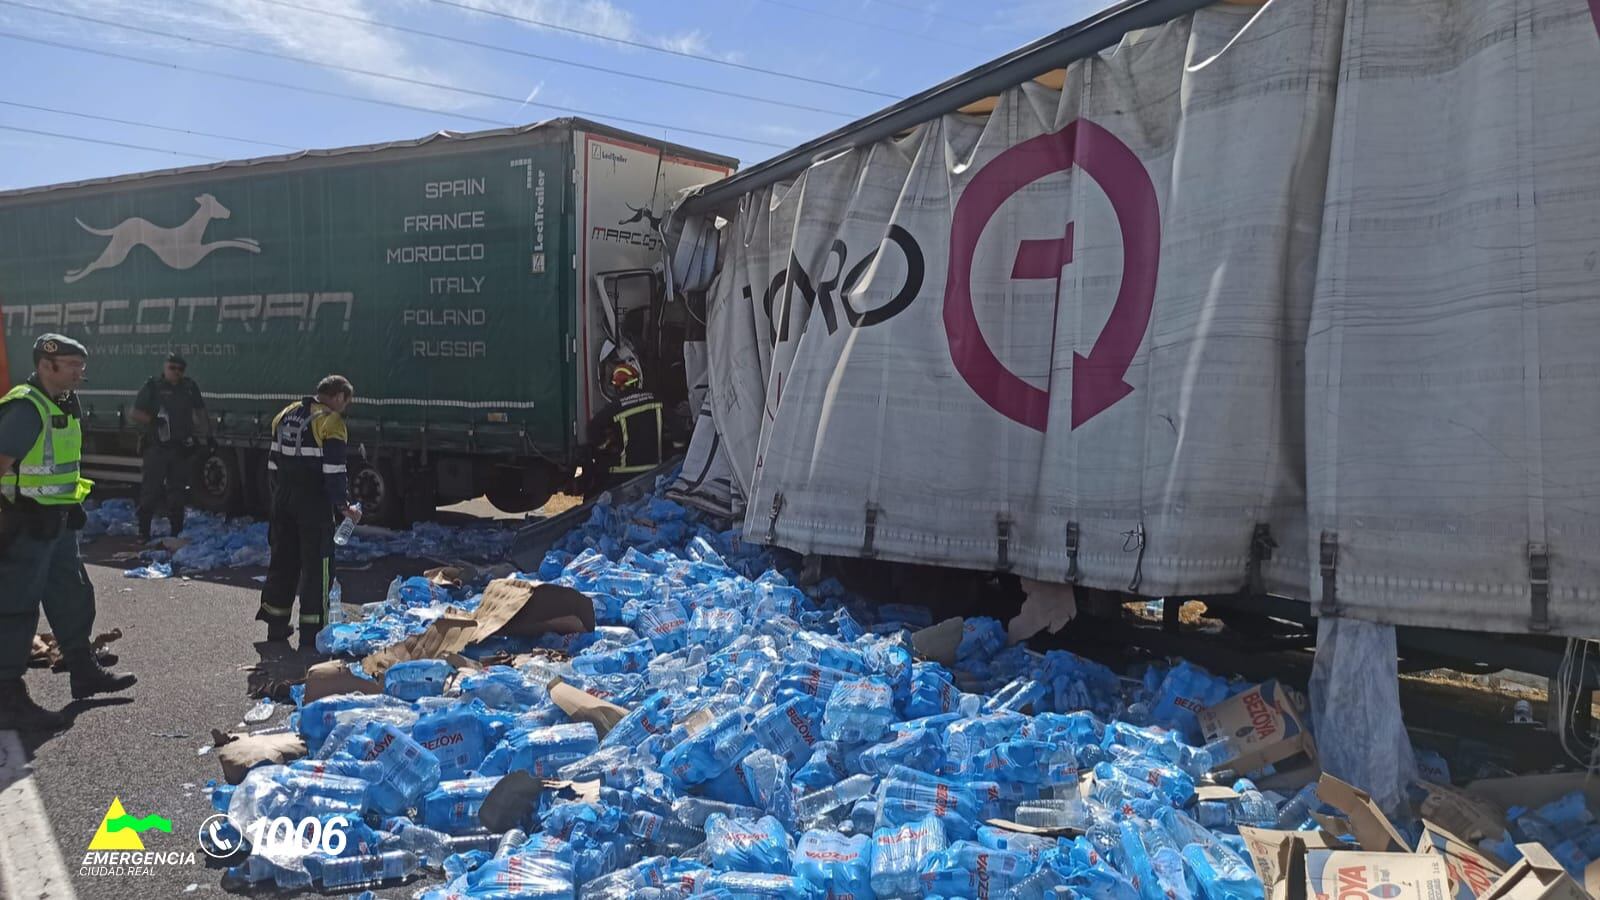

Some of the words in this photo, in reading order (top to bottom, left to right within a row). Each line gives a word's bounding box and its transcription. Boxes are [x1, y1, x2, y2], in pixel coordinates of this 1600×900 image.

[425, 178, 486, 199] SPAIN
[534, 169, 545, 252] LeciTrailer
[403, 211, 485, 232] FRANCE
[386, 244, 485, 264] MOROCCO
[429, 276, 486, 294] ITALY
[2, 292, 354, 337] MARCOTRAN
[403, 309, 486, 326] POLAND
[412, 340, 487, 358] RUSSIA
[786, 705, 816, 747] BEZOYA
[1243, 691, 1276, 740] BEZOYA
